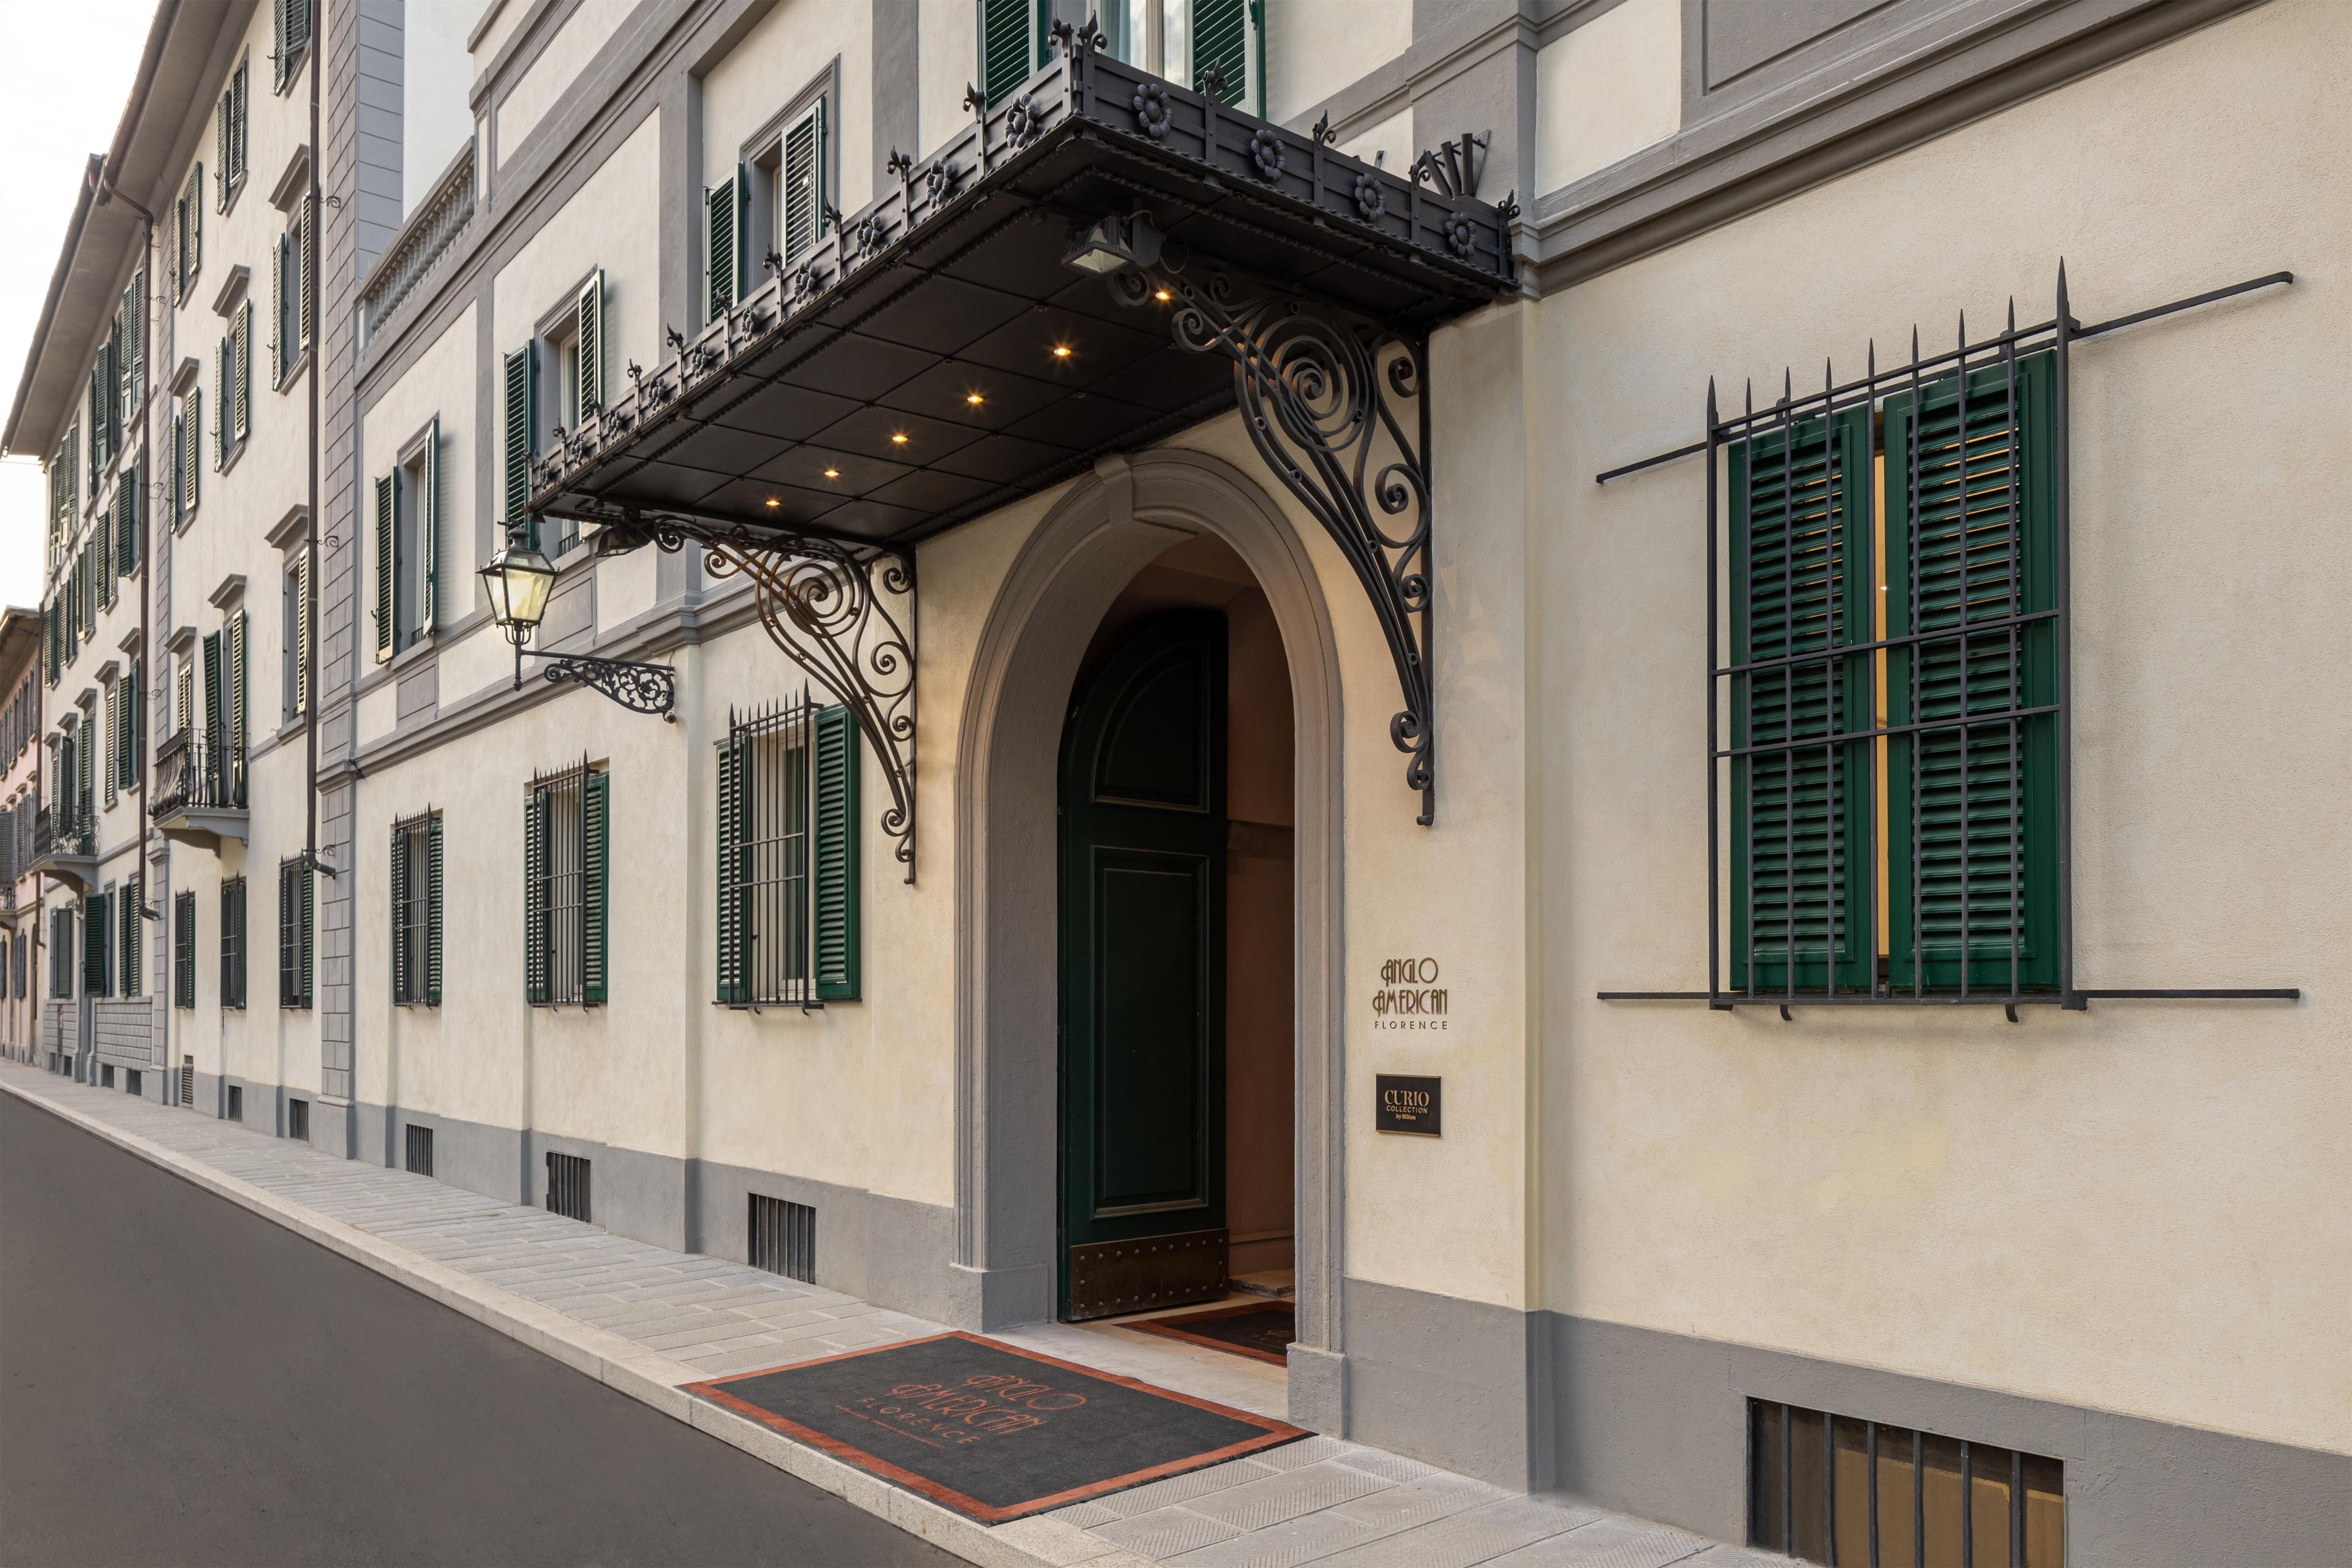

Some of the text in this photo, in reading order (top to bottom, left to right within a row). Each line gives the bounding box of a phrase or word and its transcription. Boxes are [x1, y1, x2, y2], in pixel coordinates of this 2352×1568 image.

[1381, 957, 1438, 987] ANGLO
[1373, 989, 1447, 1017] AMERICAN
[1375, 1021, 1447, 1030] FLORENCE
[1384, 1090, 1430, 1107] CURIO
[1386, 1106, 1428, 1114] COLLECTION
[961, 1374, 1087, 1409] ANGLO
[855, 1397, 980, 1444] FLORENCE
[885, 1383, 1047, 1434] AMERICAN
